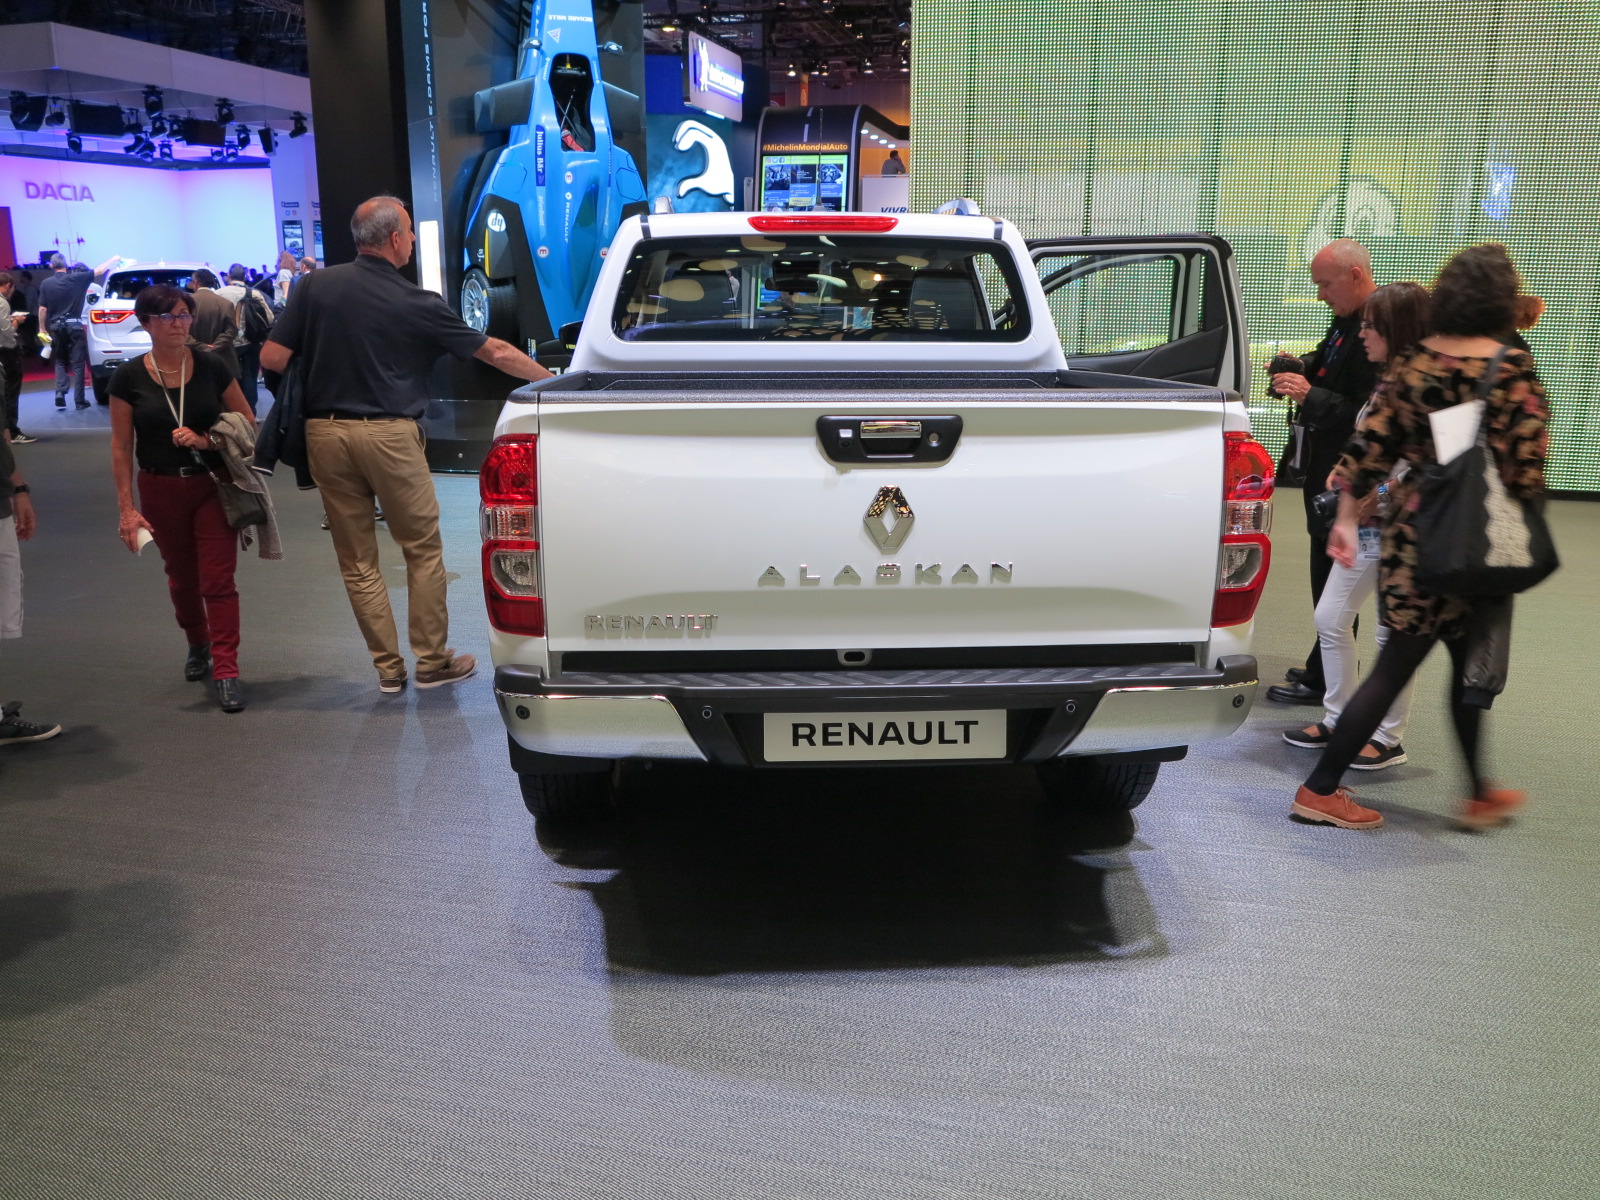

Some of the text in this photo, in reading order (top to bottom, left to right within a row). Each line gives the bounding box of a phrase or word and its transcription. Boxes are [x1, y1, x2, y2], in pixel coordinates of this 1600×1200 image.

[424, 44, 433, 116] E.DAMS
[536, 131, 544, 156] Julius
[763, 143, 848, 152] #MichelinMondialAuto
[429, 121, 438, 202] RENAULT
[25, 181, 95, 202] DACIA
[881, 206, 909, 214] VIVR
[758, 562, 1013, 585] ALASKAN
[584, 614, 718, 634] RENAULT
[791, 720, 979, 747] RENAULT
